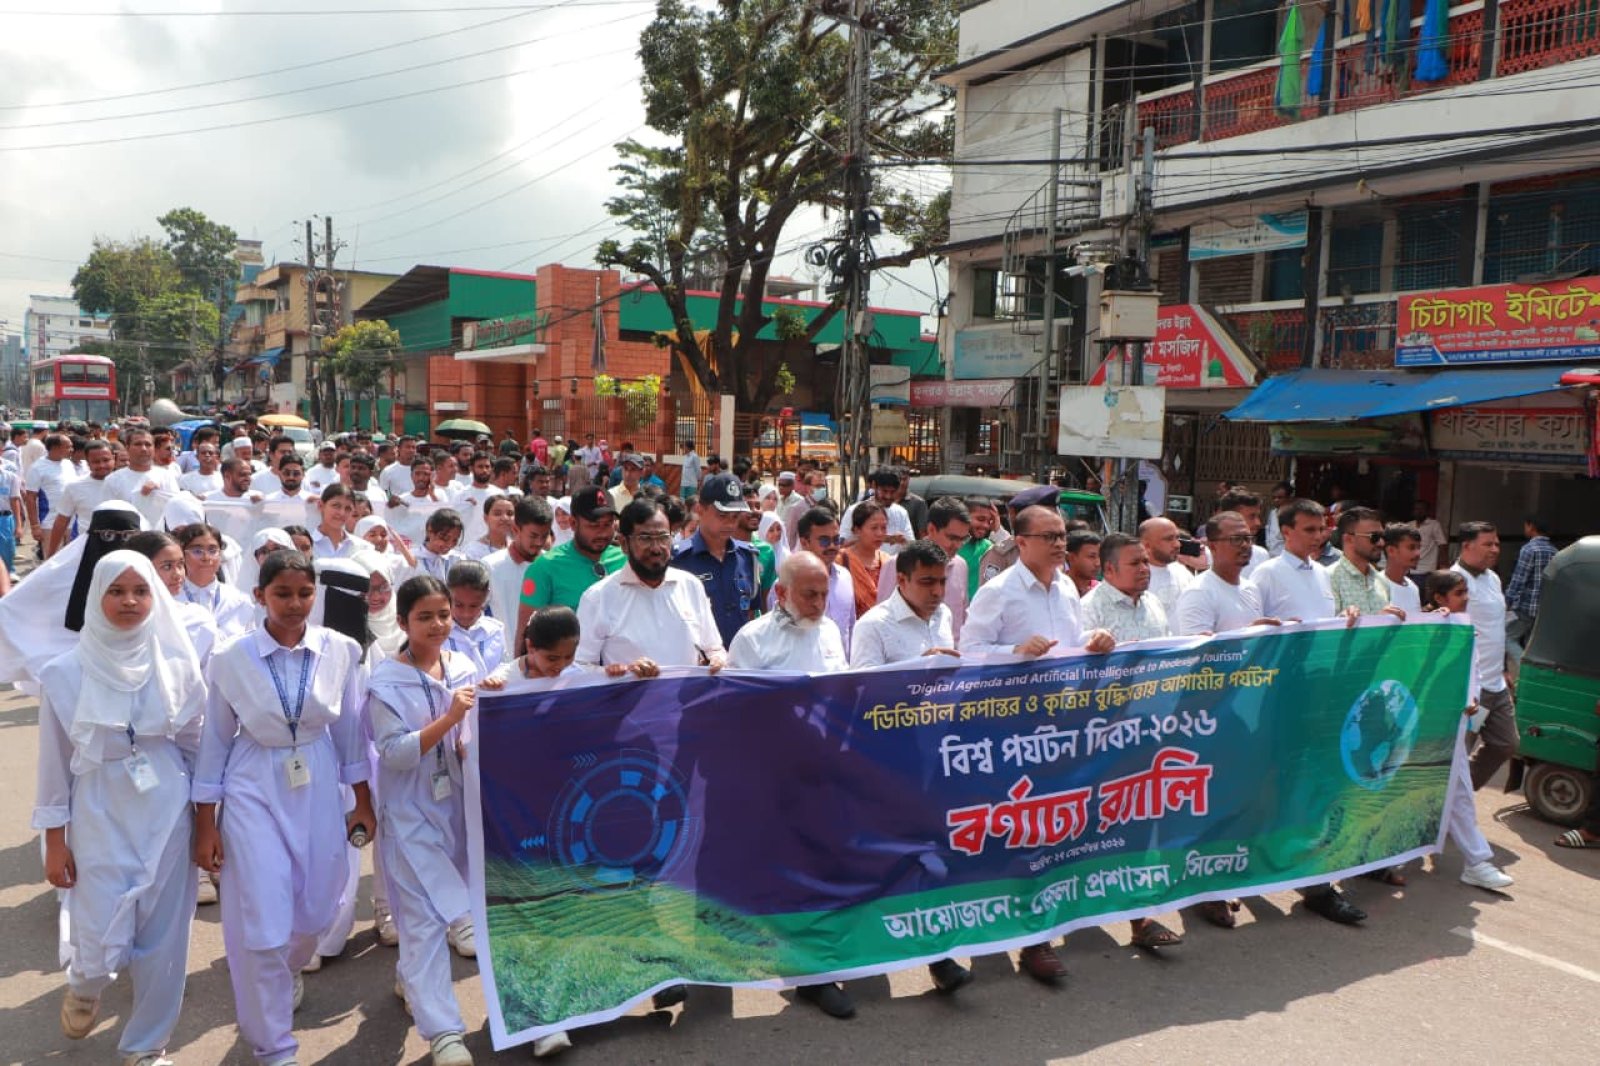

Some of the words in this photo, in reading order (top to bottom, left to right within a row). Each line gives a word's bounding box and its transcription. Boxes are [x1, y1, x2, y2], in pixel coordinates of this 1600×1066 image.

[1408, 297, 1496, 330] চিটাগাং
[1159, 333, 1201, 360] মসজিদ
[955, 676, 1002, 694] Agenda
[1004, 672, 1029, 687] and
[1029, 667, 1080, 684] Artificial
[1081, 663, 1145, 682] Intelligence
[1146, 661, 1158, 672] to
[959, 695, 1022, 722] রূপান্তর
[1025, 695, 1038, 713] ও
[1043, 686, 1091, 717] কৃত্রিম
[1160, 667, 1226, 693] আগামীর
[939, 733, 994, 777] বিশ্ব
[1001, 721, 1079, 768] পর্যটন
[1083, 708, 1218, 757] দিবস-২০২৬
[946, 774, 1093, 857] বর্ণাঢ্য
[1031, 876, 1081, 916] জেলা
